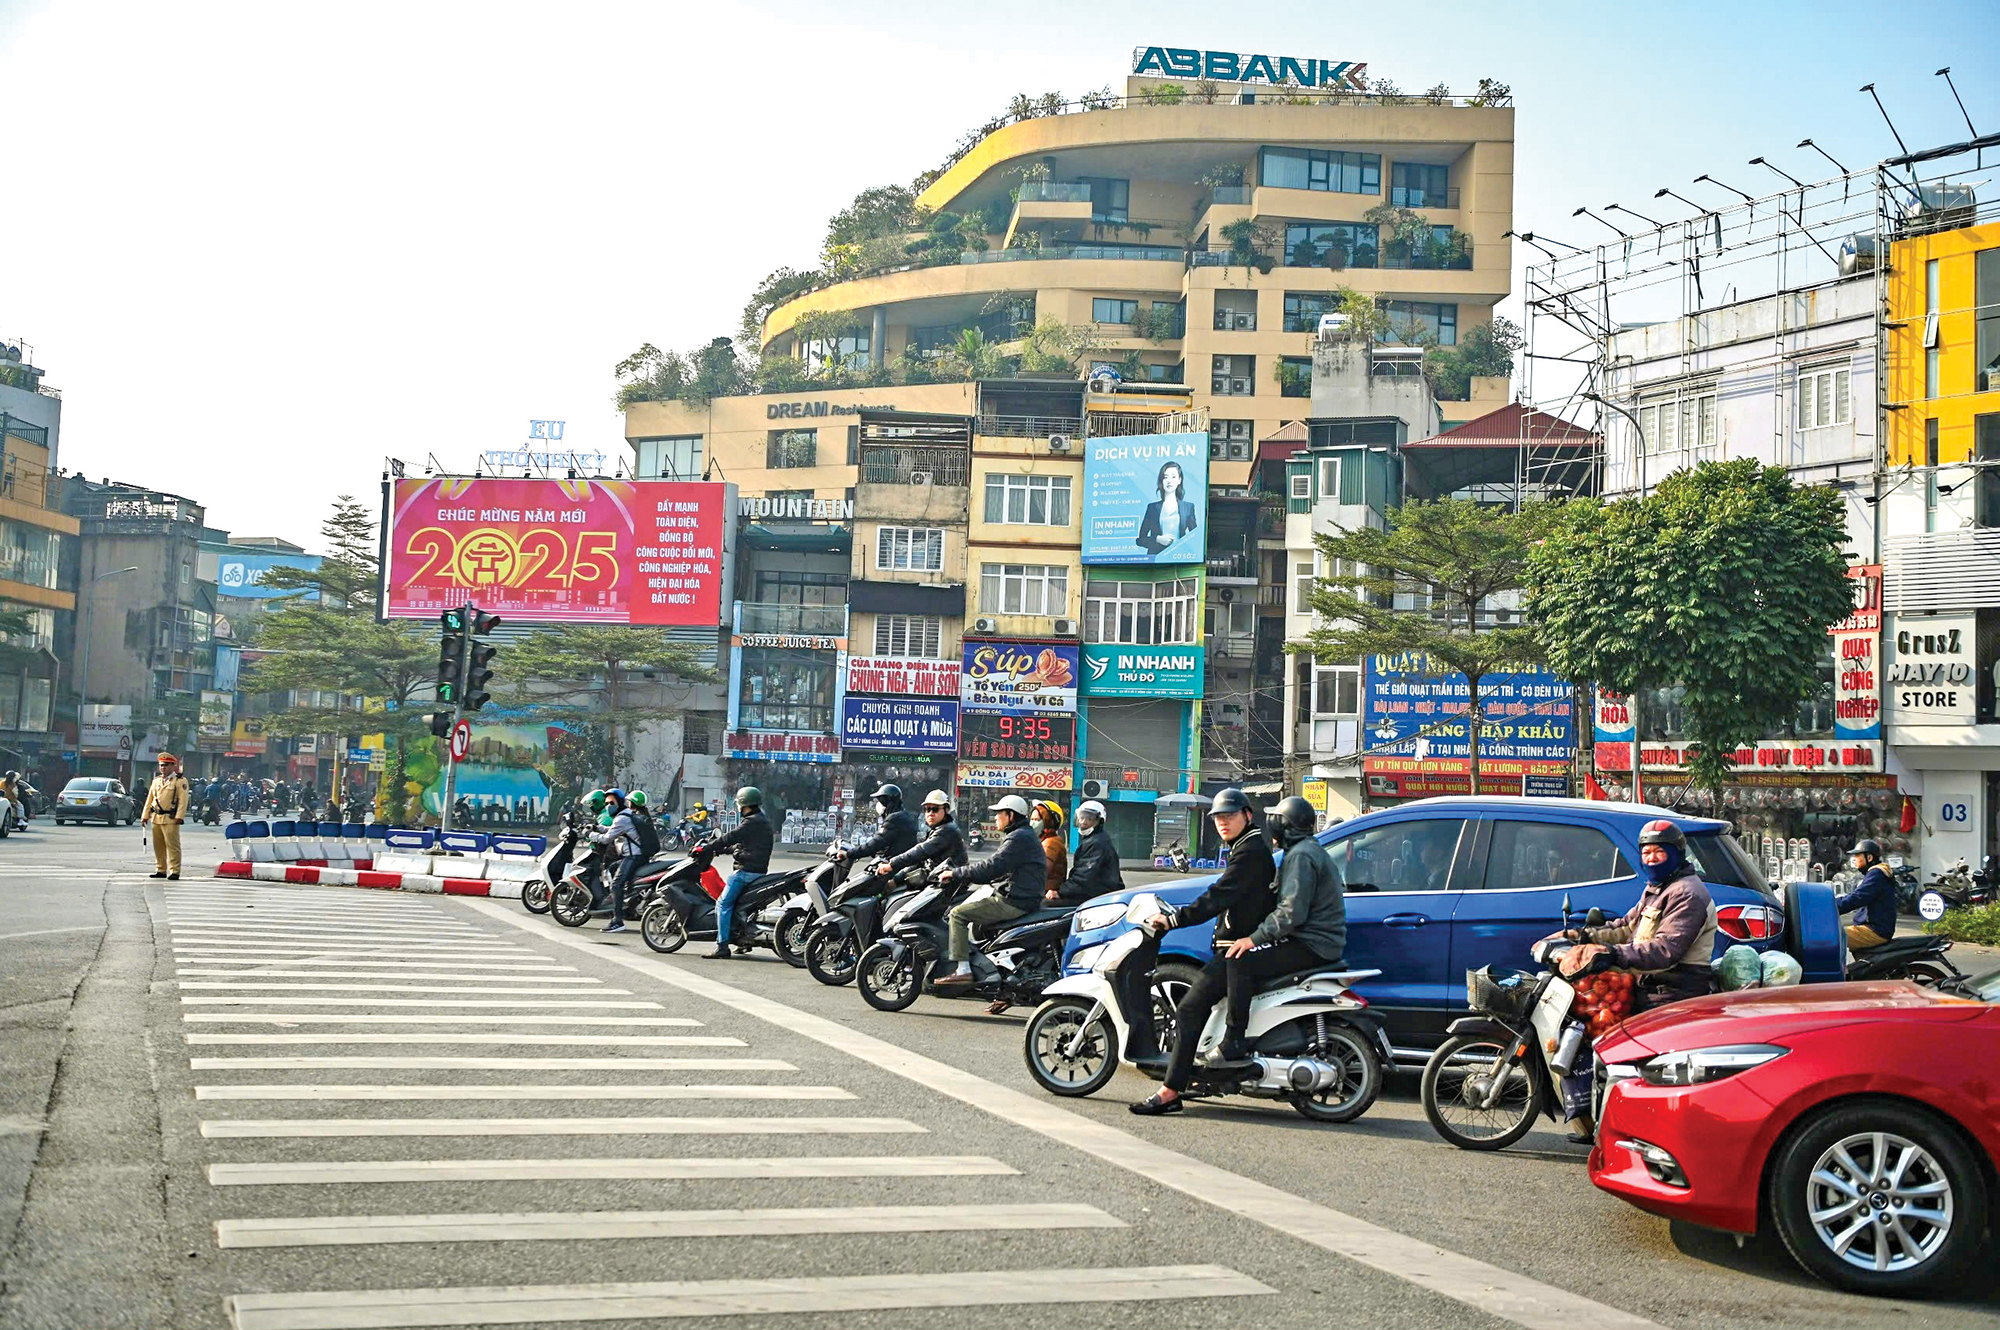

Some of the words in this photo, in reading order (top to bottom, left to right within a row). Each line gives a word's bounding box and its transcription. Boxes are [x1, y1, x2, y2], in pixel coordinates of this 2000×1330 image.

[1134, 46, 1365, 90] ABBANK
[766, 401, 829, 419] DREAM
[529, 419, 566, 440] EU
[1095, 446, 1128, 463] DỊCH
[1132, 445, 1152, 461] VỤ
[1156, 445, 1170, 457] IN
[437, 507, 476, 522] CHÚC
[480, 507, 521, 523] MỪNG
[524, 507, 556, 523] NĂM
[559, 508, 587, 524] MỚI
[674, 501, 699, 514] MẠNH
[737, 497, 854, 519] MOUNTAIN
[656, 515, 677, 528] TOÀN
[677, 515, 699, 529] DIỆN,
[1094, 521, 1103, 529] IN
[1104, 520, 1135, 528] NHANH
[659, 529, 681, 543] ĐỒNG
[683, 530, 694, 545] BỘ
[405, 527, 619, 591] 2025
[636, 545, 658, 558] CÔNG
[659, 545, 681, 560] CUỘC
[682, 544, 696, 559] ĐỔI
[638, 560, 660, 573] CÔNG
[662, 561, 692, 575] NGHIỆP
[648, 576, 667, 591] HIỆN
[668, 578, 683, 591] ĐẠI
[684, 576, 701, 589] HÓA
[651, 590, 667, 604] ĐẤT
[668, 591, 691, 604] NƯỚC
[1857, 615, 1866, 629] 35
[1867, 615, 1878, 628] 68
[741, 636, 779, 648] COFFEE
[782, 636, 812, 649] JUICE
[816, 638, 837, 650] TEA
[1842, 638, 1872, 661] QUẠT
[1897, 629, 1961, 655] GrusZ
[850, 658, 871, 668] CỬA
[873, 659, 903, 670] HÀNG
[906, 661, 929, 674] ĐIỆN
[932, 663, 960, 674] LẠNH
[970, 647, 1034, 681] Súp
[1117, 655, 1134, 670] IN
[1136, 655, 1195, 671] NHANH
[849, 668, 885, 692] CHUNG
[937, 672, 960, 696] SƠN
[1117, 669, 1137, 682] THỦ
[1139, 671, 1155, 682] ĐÔ
[1841, 667, 1874, 691] CÔNG
[973, 678, 990, 691] Tổ
[990, 680, 1014, 692] Yến
[1375, 680, 1390, 695] THẾ
[1391, 681, 1408, 696] GIỚI
[1409, 684, 1430, 698] QUẠT
[1454, 681, 1471, 696] ĐÈN
[1501, 683, 1514, 697] TRÍ
[1521, 683, 1533, 697] CÓ
[1534, 683, 1551, 698] ĐÈN
[1552, 683, 1565, 698] VÀ
[973, 692, 997, 703] Bào
[998, 694, 1025, 706] Ngư
[1048, 695, 1065, 707] Cá
[1373, 698, 1388, 713] ĐÀI
[1388, 701, 1409, 714] LOAN
[1414, 699, 1436, 716] NHẬT
[1486, 700, 1504, 714] HÀN
[1505, 699, 1528, 716] QUỐC
[1553, 702, 1570, 716] LAN
[1901, 691, 1957, 707] STORE
[862, 702, 891, 714] CHUYÊN
[893, 704, 912, 715] KINH
[914, 704, 940, 716] DOANH
[1836, 695, 1879, 722] NGHIỆP
[846, 714, 867, 734] CÁC
[869, 718, 892, 738] LOẠI
[893, 720, 919, 739] QUẠT
[921, 720, 928, 736] 4
[930, 717, 953, 737] MÙA
[1000, 717, 1051, 740] 9:35
[1419, 721, 1465, 738] HÀNG
[1477, 722, 1514, 741] HẬP
[1517, 719, 1566, 739] KHẨU
[964, 737, 988, 758] YẾN
[1437, 743, 1451, 757] TẠI
[1453, 742, 1471, 756] NHÀ
[1488, 743, 1514, 757] CÔNG
[1516, 743, 1544, 757] TRÌNH
[1545, 744, 1565, 758] CÁC
[1757, 747, 1791, 769] QUẠT
[1792, 743, 1825, 770] ĐIỆN
[1827, 748, 1839, 765] 4
[1841, 744, 1874, 766] MÙA
[1374, 760, 1385, 769] UY
[1386, 759, 1401, 770] TÍN
[1420, 761, 1438, 771] HƠN
[1440, 760, 1463, 772] VÀNG
[1494, 763, 1523, 775] LƯỢNG
[1530, 761, 1548, 774] BẢO
[964, 777, 986, 786] LÊN
[988, 778, 1010, 787] ĐẾN
[1015, 771, 1067, 788] 20%
[1305, 782, 1325, 792] NHẬN
[1405, 783, 1427, 791] QUẠT
[1428, 782, 1444, 791] HƠI
[1446, 783, 1469, 792] NƯỚC
[1307, 791, 1322, 800] SỬA
[1941, 803, 1967, 822] 03
